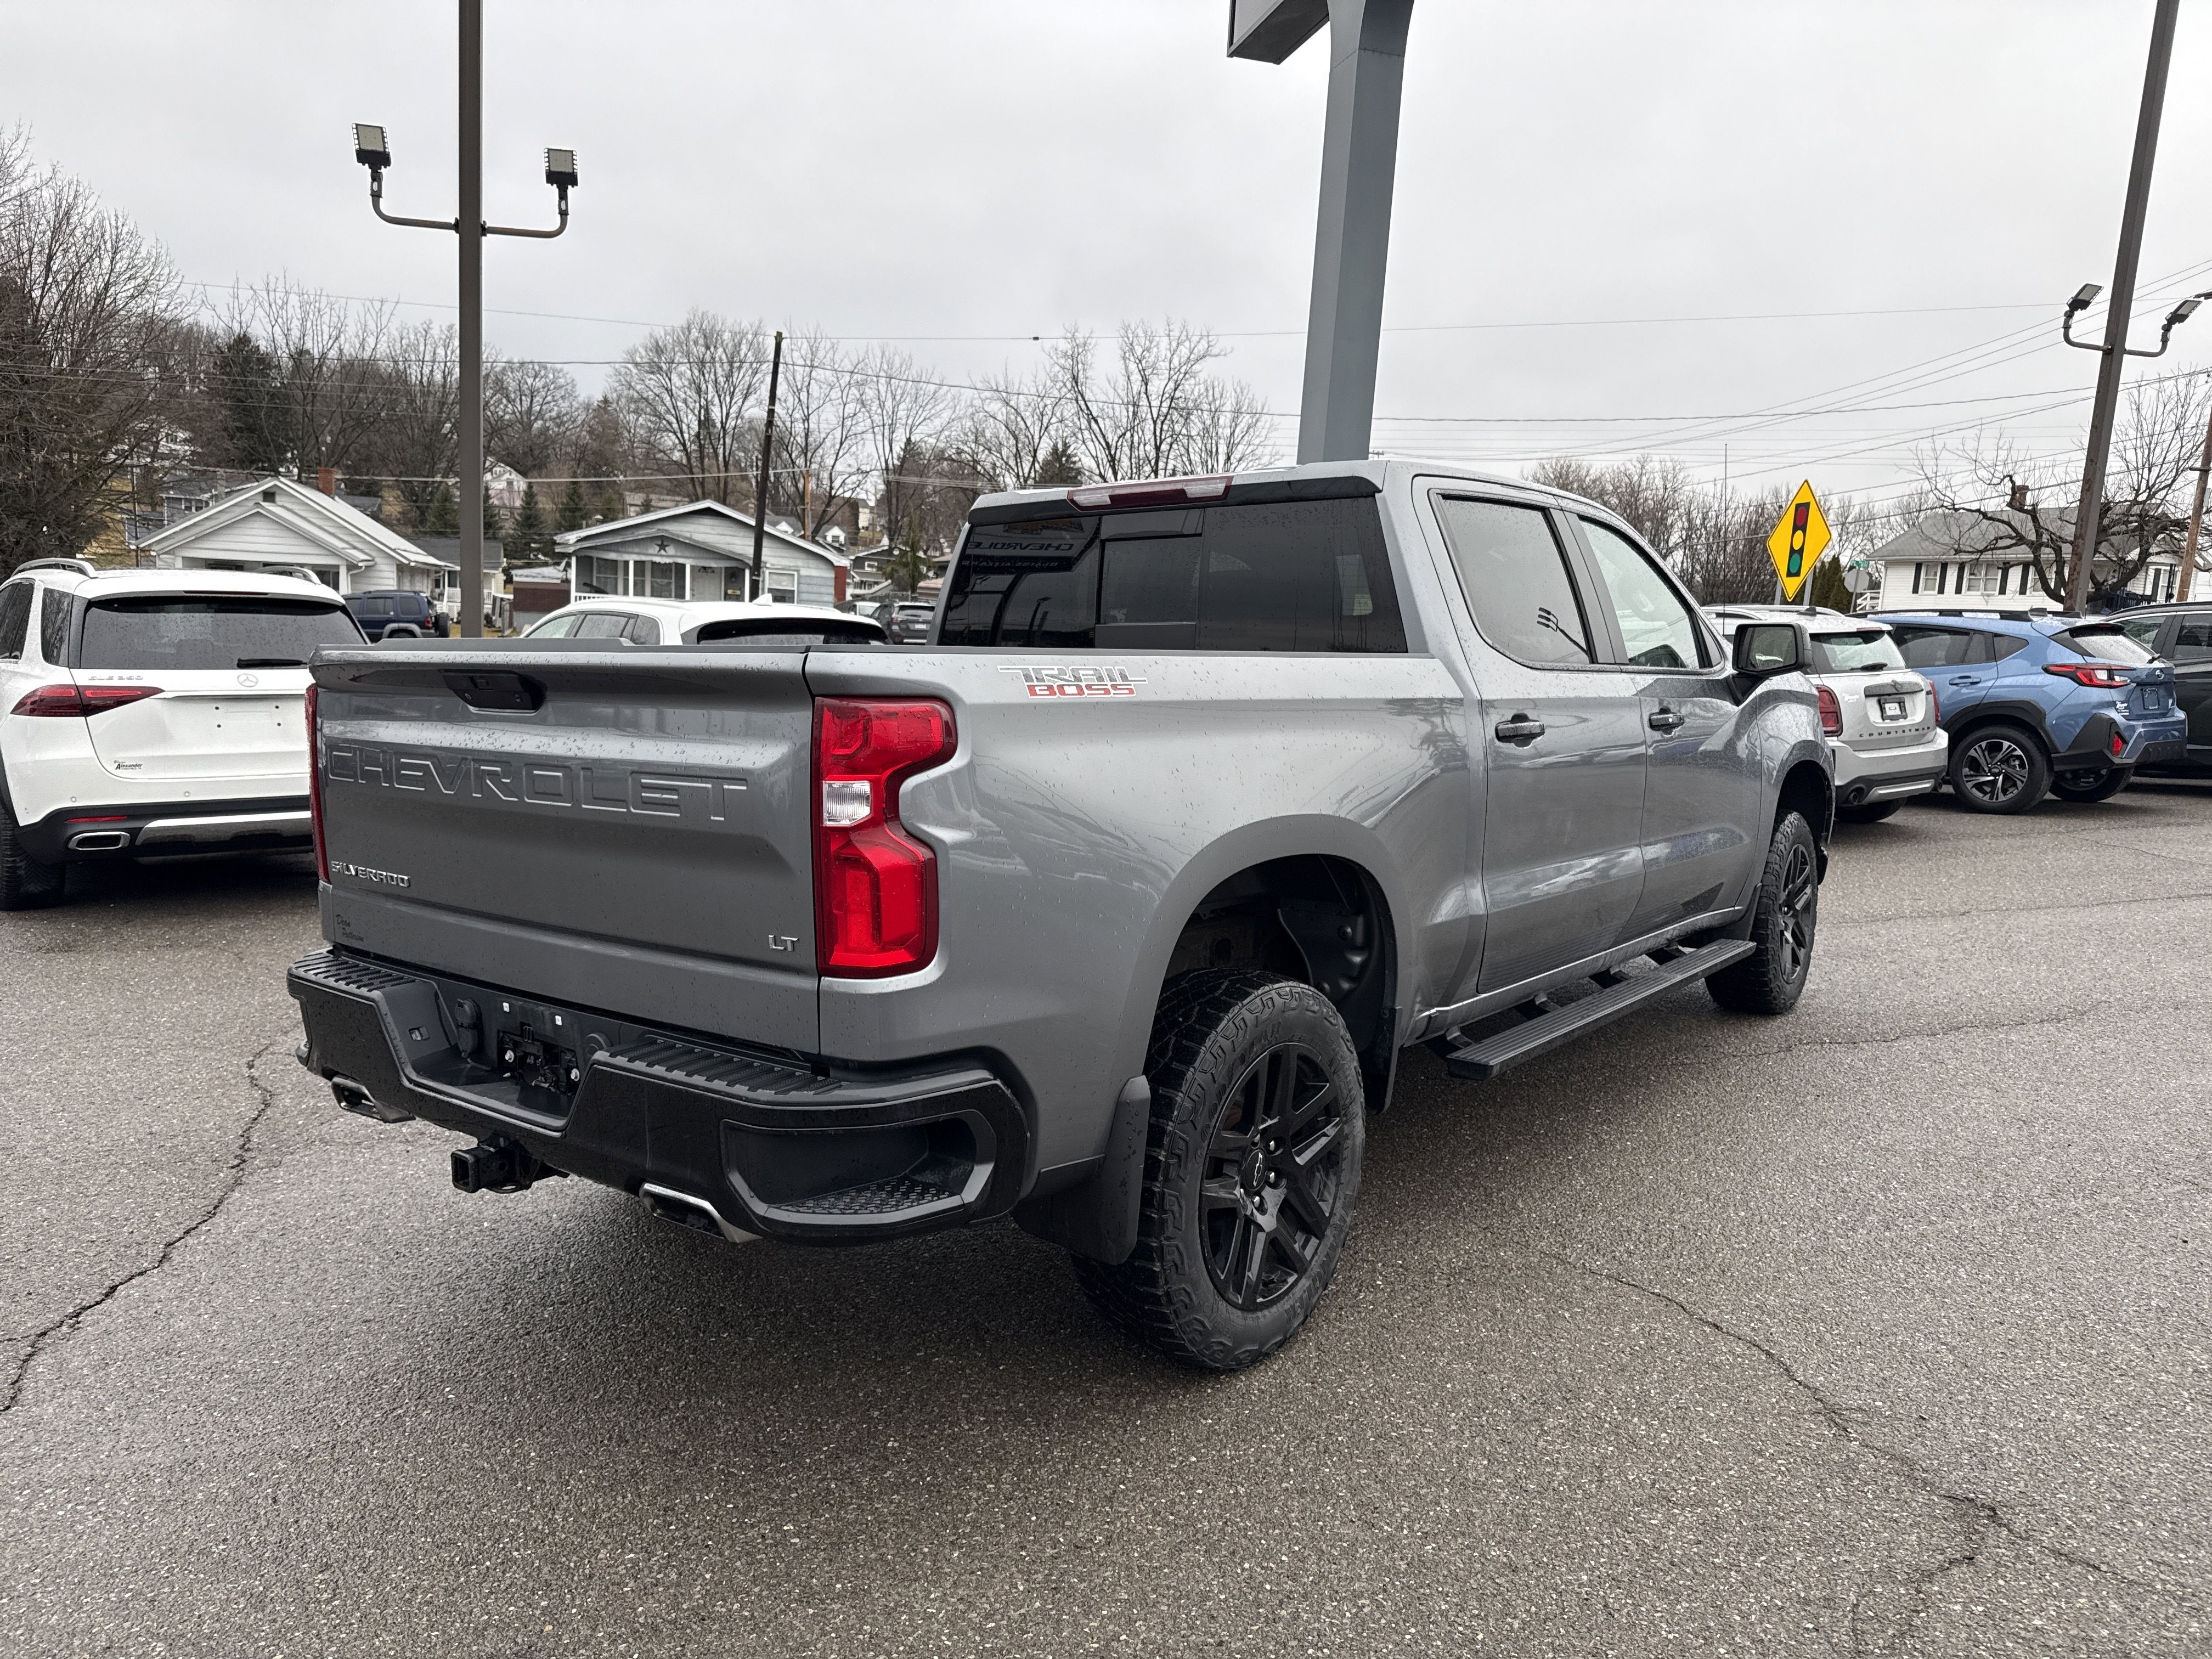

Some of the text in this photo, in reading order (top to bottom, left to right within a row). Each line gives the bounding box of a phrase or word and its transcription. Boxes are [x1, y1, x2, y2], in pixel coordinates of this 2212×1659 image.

[997, 665, 1148, 684] TRAIL
[1025, 684, 1136, 698] BOSS
[329, 745, 748, 821] CHEVROLET
[331, 861, 410, 888] SILVERADO
[768, 934, 799, 952] LT
[1284, 1192, 1355, 1325] WRANGLER
